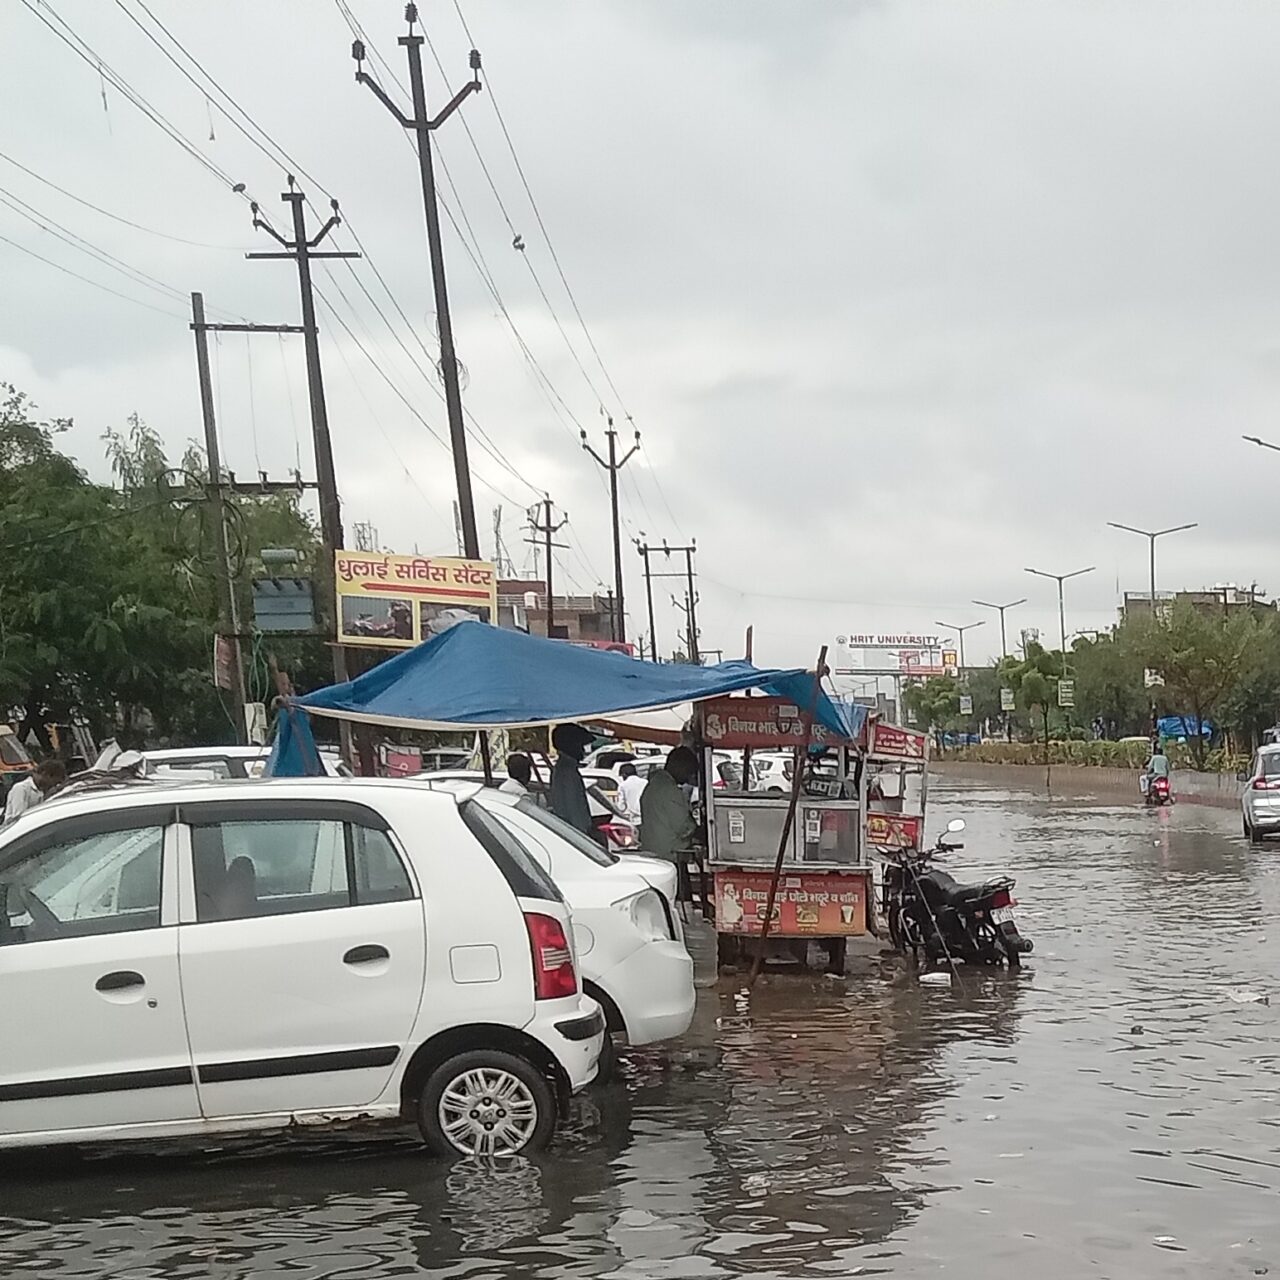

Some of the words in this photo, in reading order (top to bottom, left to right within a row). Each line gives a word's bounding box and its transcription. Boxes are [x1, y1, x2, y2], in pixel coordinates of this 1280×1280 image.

[338, 557, 389, 582] धुलाई
[395, 559, 447, 582] सर्विस
[453, 564, 493, 585] सेंटर
[850, 635, 875, 644] HRIT
[877, 636, 939, 646] UNIVERSITY
